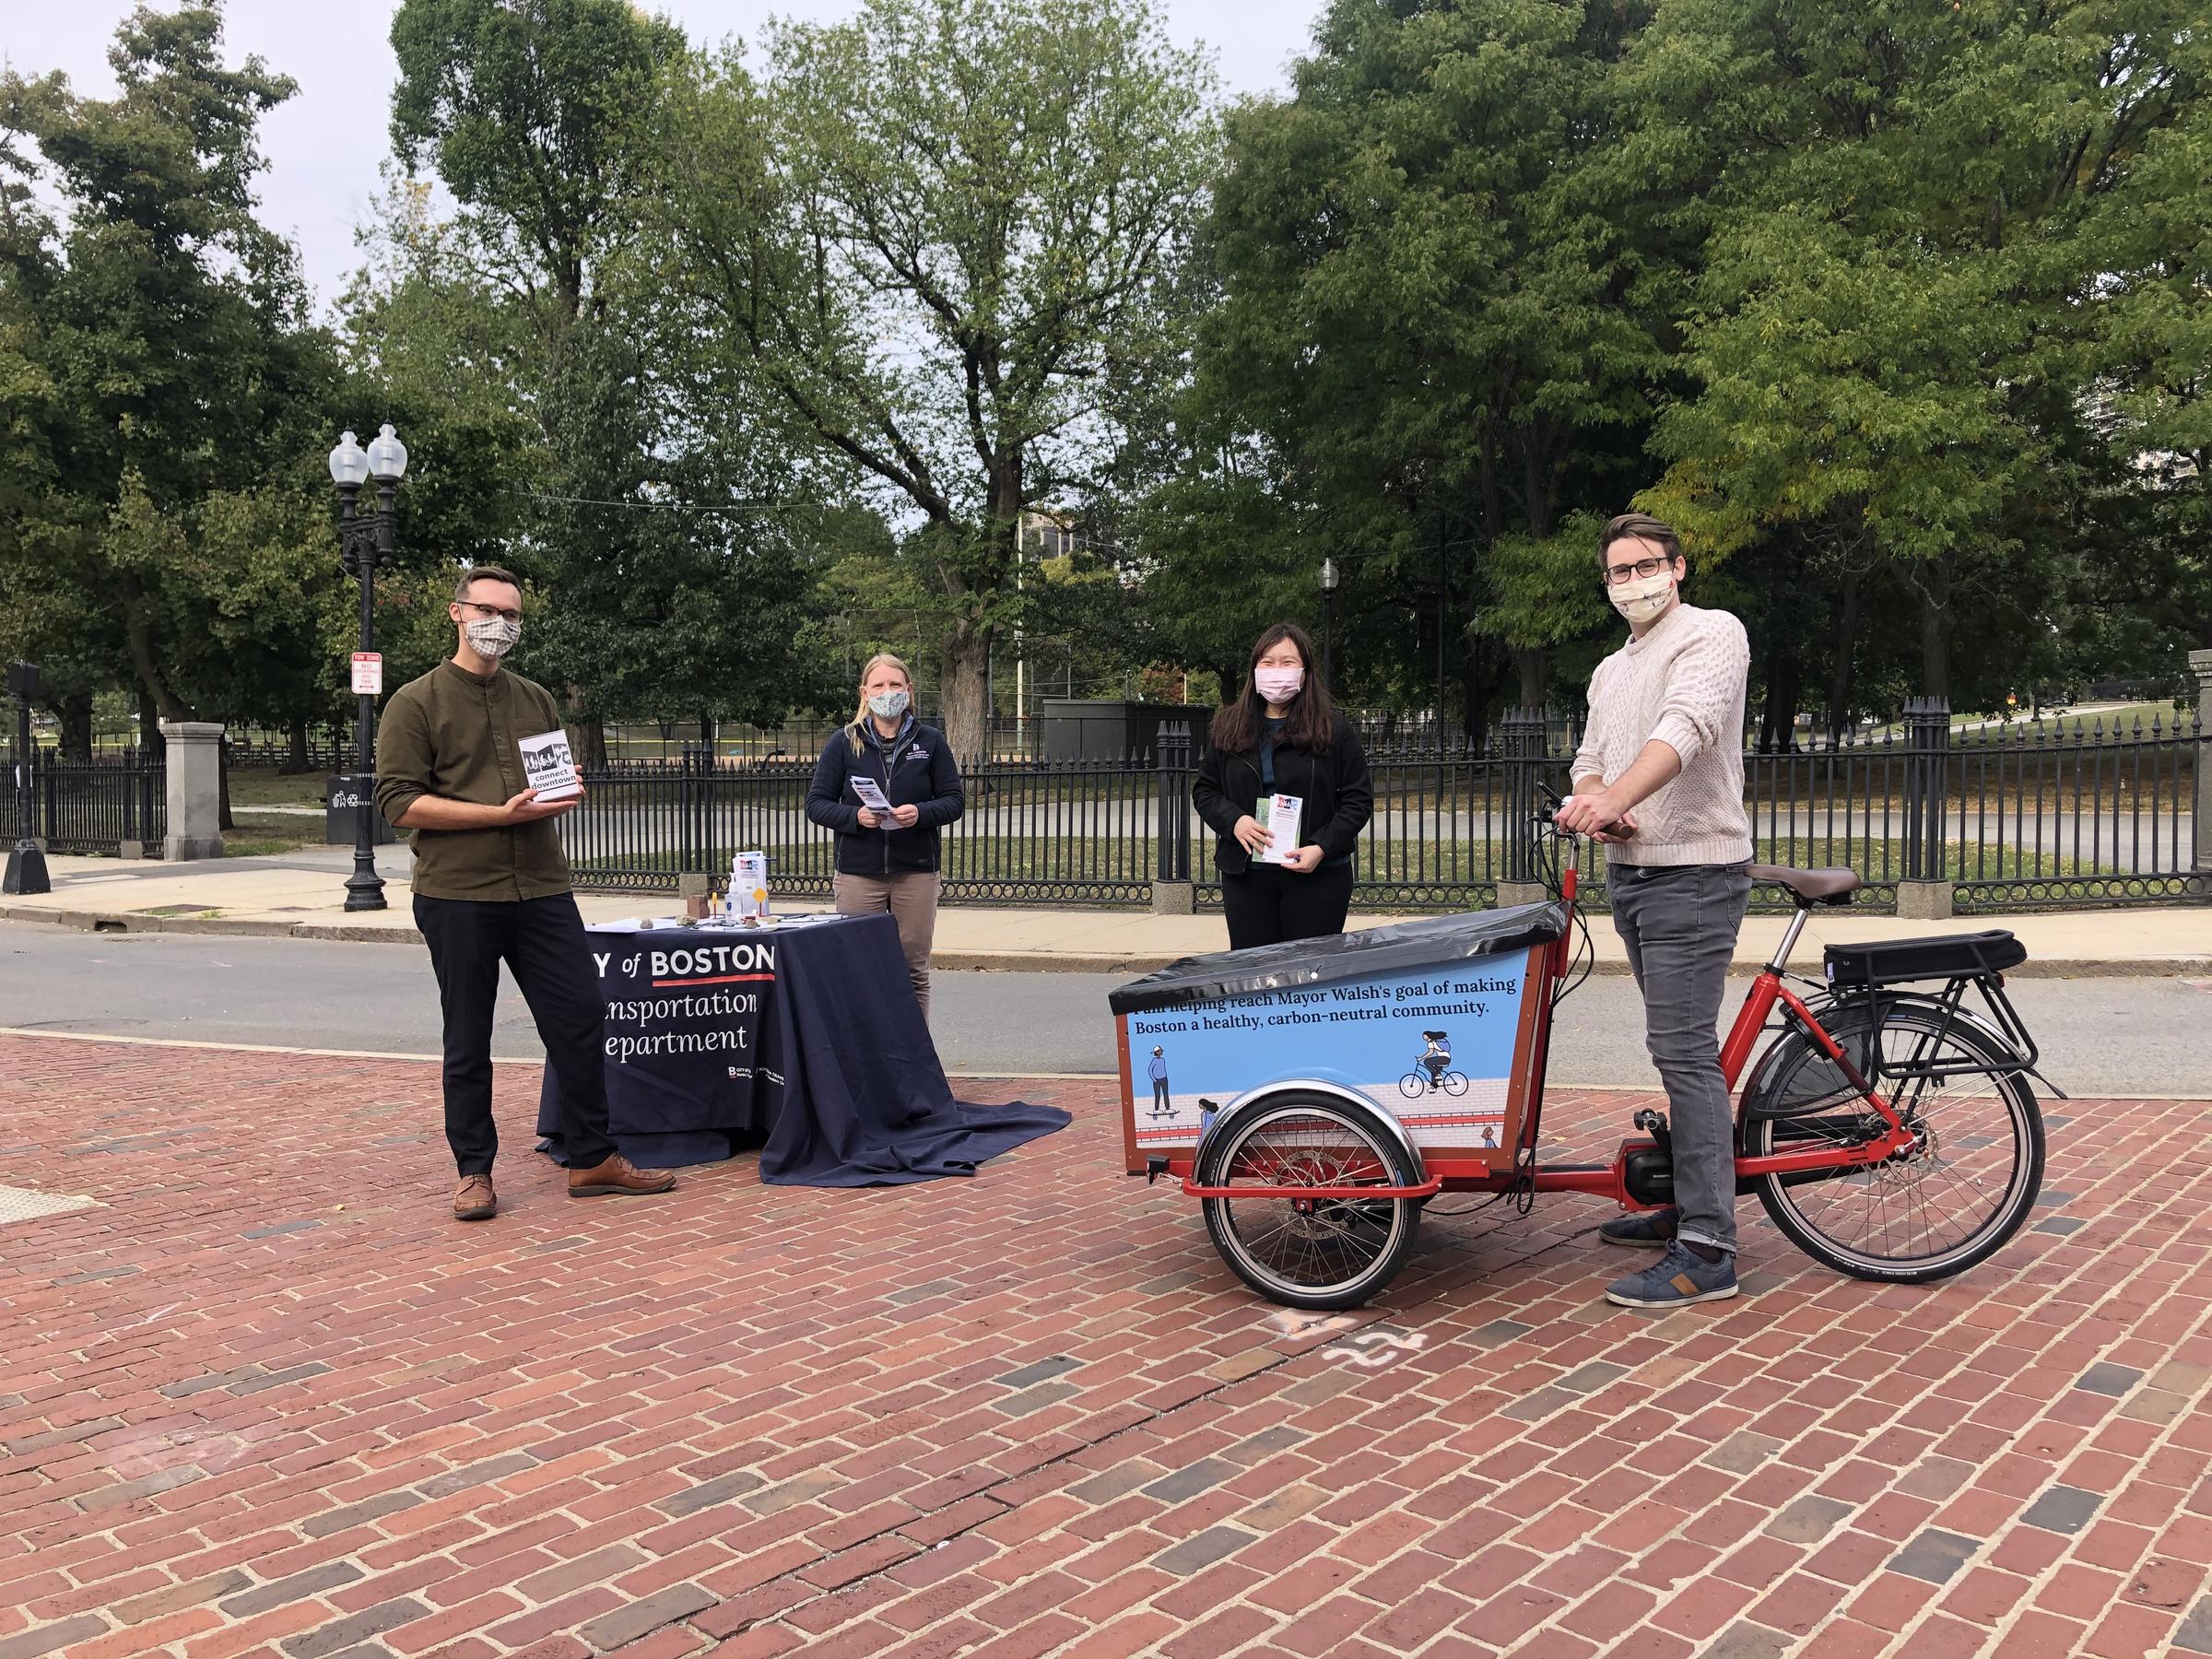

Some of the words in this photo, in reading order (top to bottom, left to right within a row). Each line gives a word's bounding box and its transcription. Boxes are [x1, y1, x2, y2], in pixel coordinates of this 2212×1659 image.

[531, 775, 576, 790] downtown
[535, 769, 568, 782] connect
[621, 952, 641, 978] of
[651, 944, 775, 977] BOSTON
[604, 989, 757, 1028] nsportation
[1230, 993, 1273, 1007] reach
[1277, 991, 1327, 1009] Mayor
[1332, 985, 1391, 1002] Walsh's
[1395, 982, 1429, 1001] goal
[1433, 981, 1450, 995] of
[1454, 978, 1516, 995] making
[1135, 1019, 1187, 1034] Boston
[1191, 1020, 1199, 1031] a
[1203, 1015, 1264, 1031] healthy,
[1268, 1005, 1387, 1026] carbon-neutral
[1392, 999, 1489, 1018] community.
[605, 1026, 747, 1064] epartment
